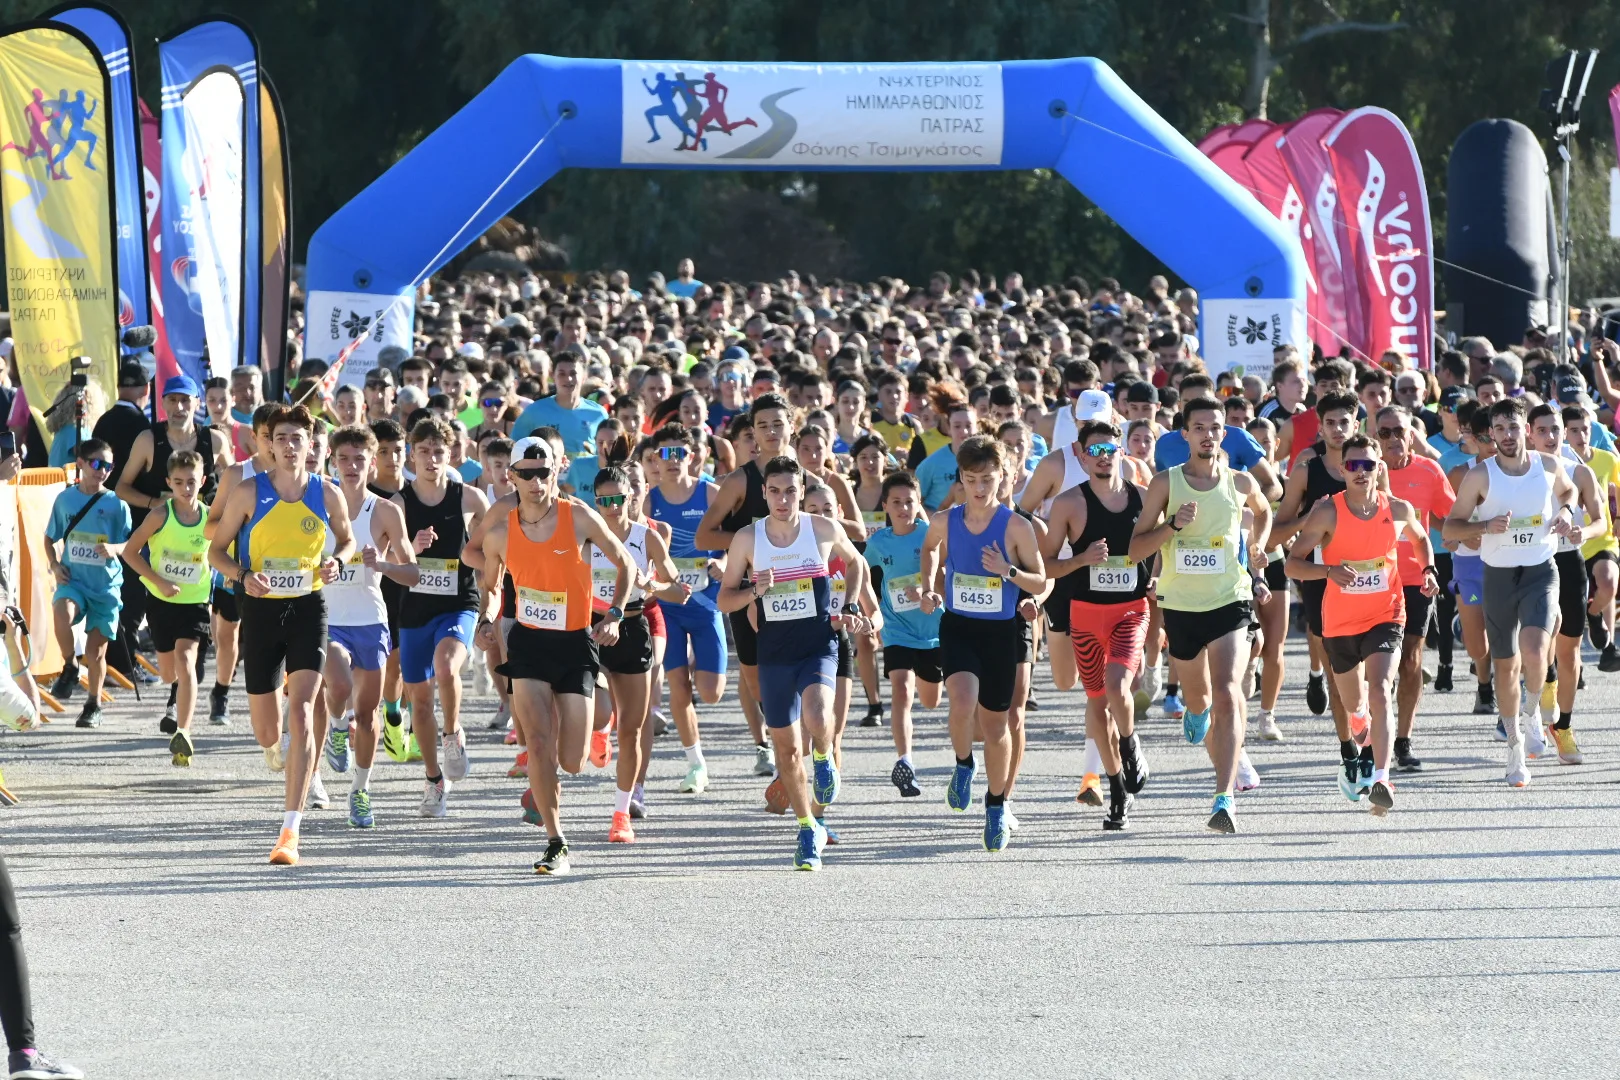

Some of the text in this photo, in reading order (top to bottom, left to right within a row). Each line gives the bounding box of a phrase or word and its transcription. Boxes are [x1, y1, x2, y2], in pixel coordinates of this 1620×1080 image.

[846, 94, 984, 110] ΗΜΙΜΑΡΑΘΩΝΙΟΣ
[920, 117, 984, 133] ΠΑΤΡΑΣ
[792, 141, 984, 158] Φάνης Τσιμιγκάτος
[330, 306, 341, 340] COFFEE
[1227, 313, 1238, 347] COFFEE
[1512, 533, 1534, 544] 167
[71, 546, 99, 559] 6028
[1184, 554, 1217, 567] 6296
[165, 564, 195, 578] 6447
[1097, 572, 1130, 584] 6310
[270, 575, 304, 588] 6207
[419, 574, 451, 587] 6265
[960, 591, 993, 605] 6453
[772, 598, 807, 613] 6425
[525, 605, 557, 621] 6426
